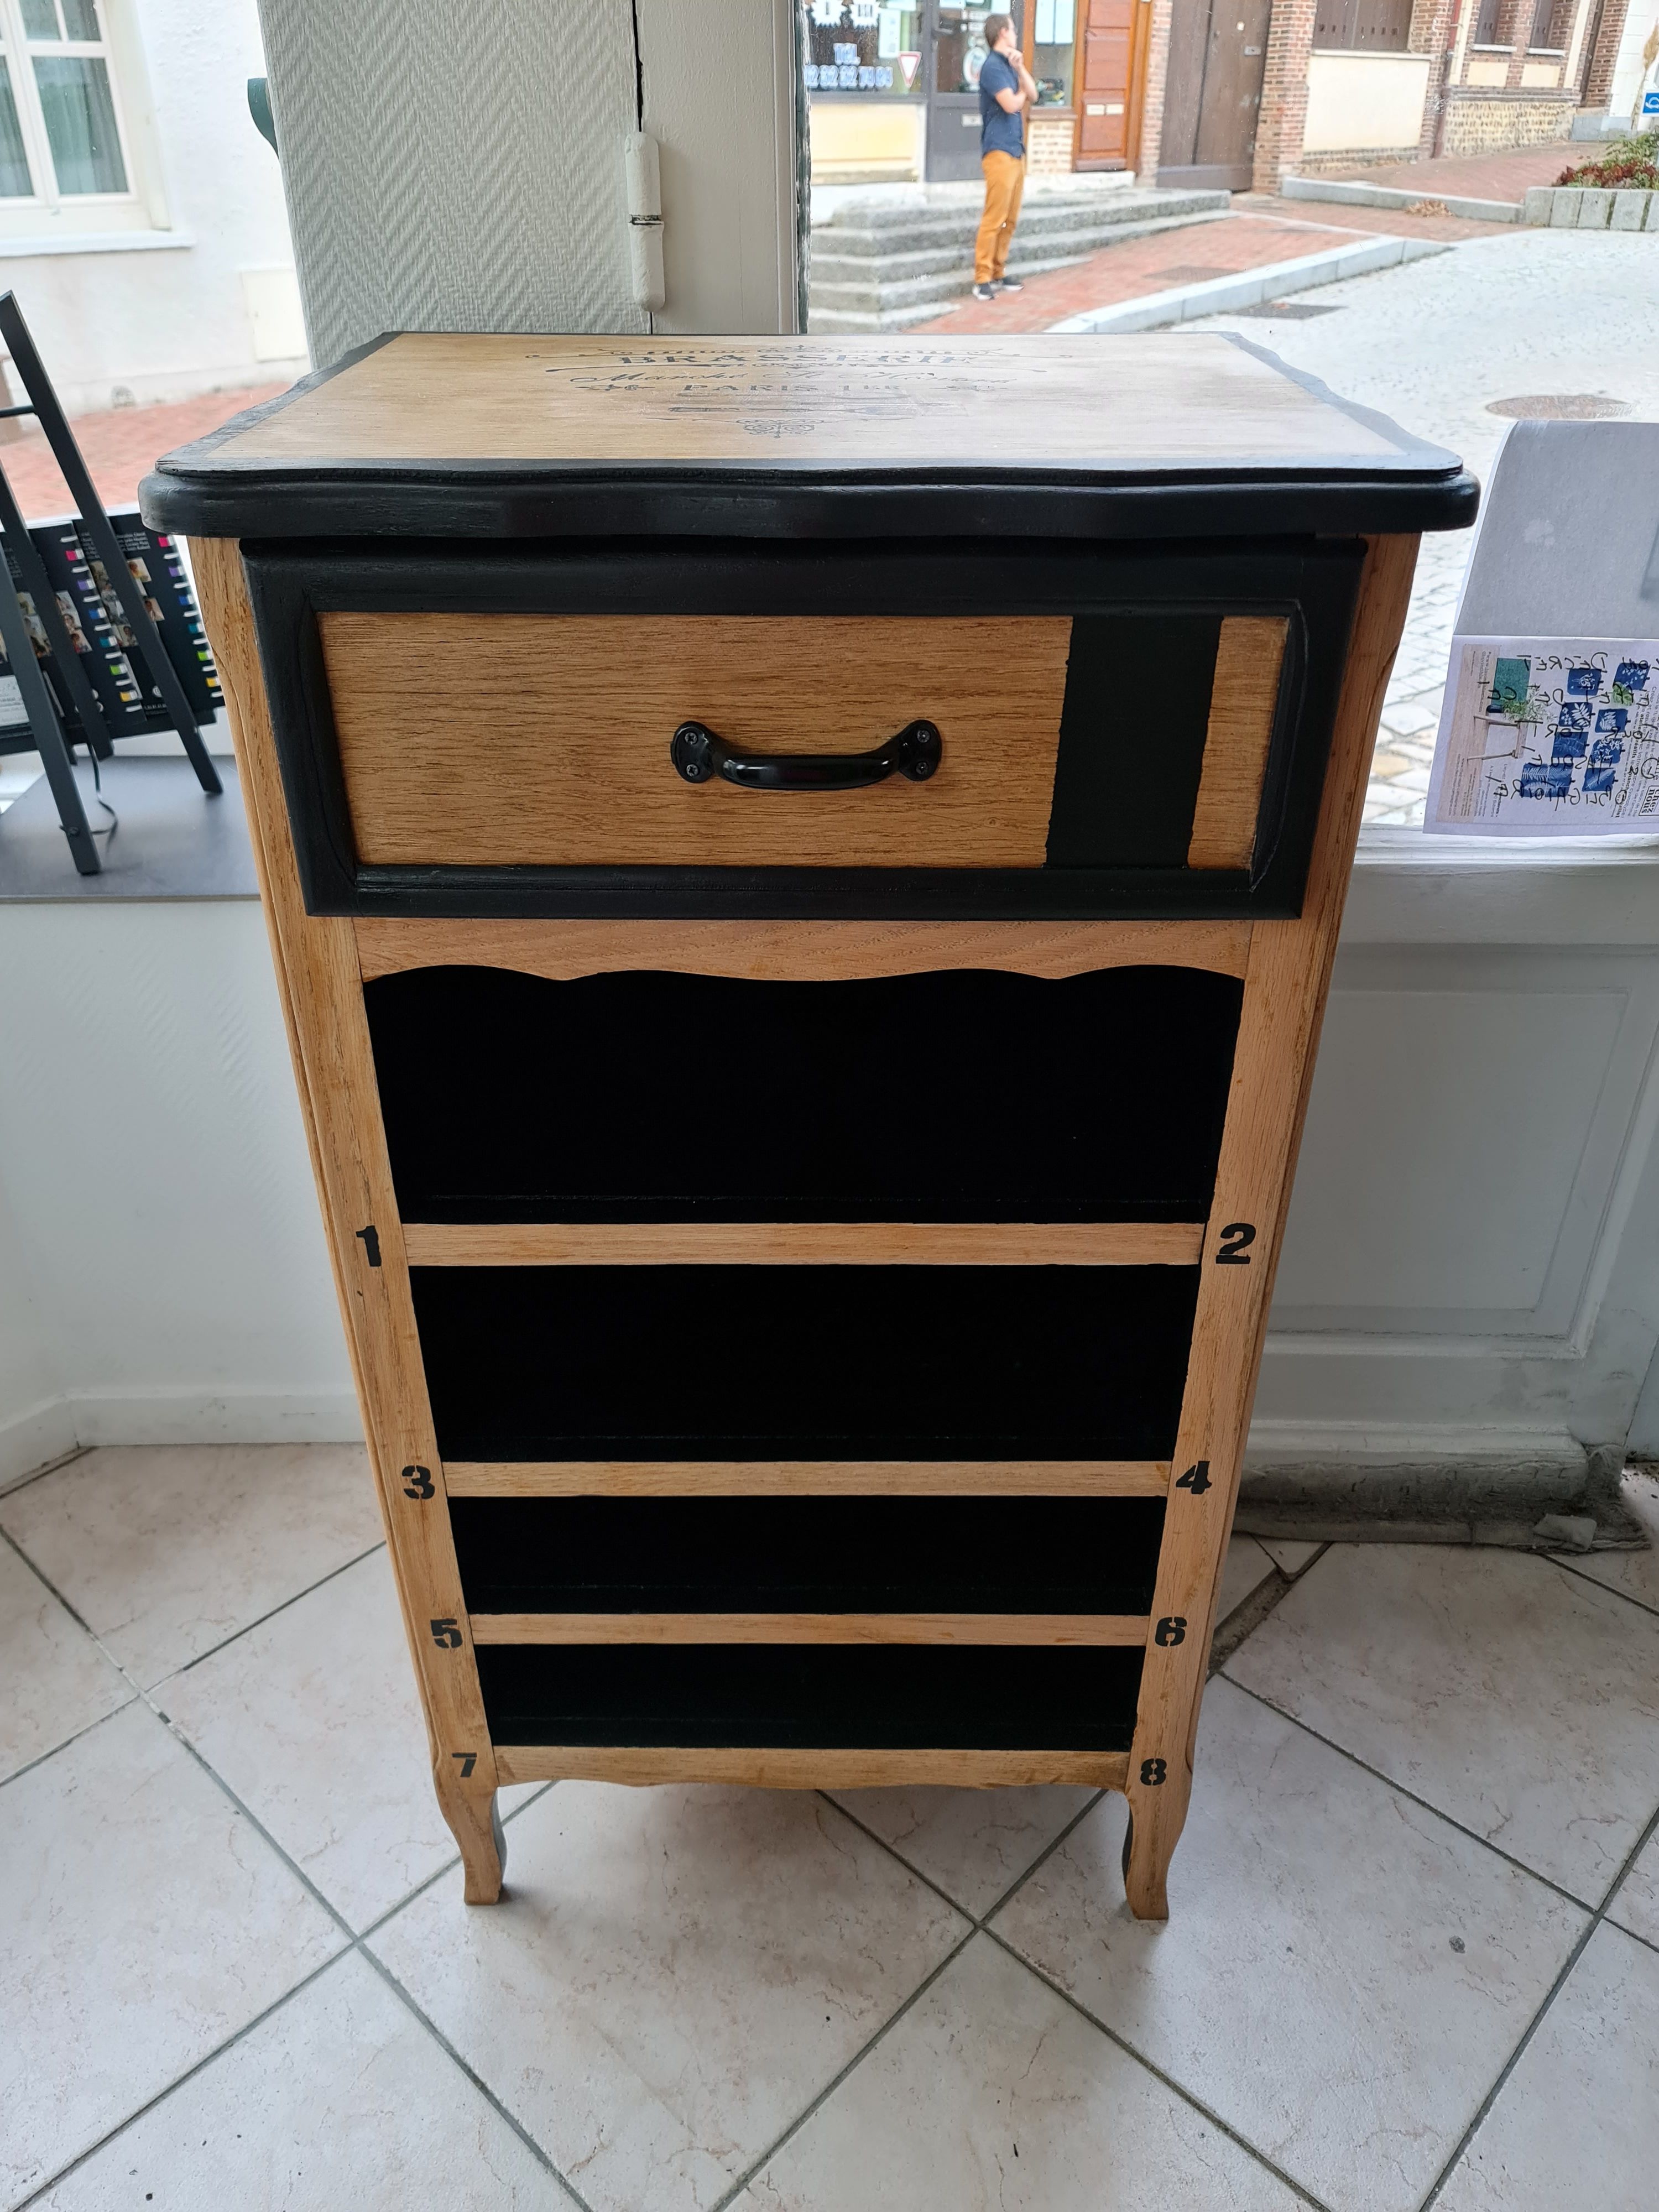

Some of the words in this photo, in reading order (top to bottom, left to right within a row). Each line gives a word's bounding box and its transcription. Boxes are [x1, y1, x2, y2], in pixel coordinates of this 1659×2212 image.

[619, 354, 977, 364] BRASSERIE
[1641, 789, 1655, 813] nous
[356, 1225, 382, 1266] 1
[1215, 1223, 1256, 1264] 2
[402, 1465, 435, 1499] 3
[1176, 1460, 1212, 1494] 4
[430, 1618, 463, 1648] 5
[1155, 1616, 1187, 1647] 6
[452, 1752, 477, 1777] 7
[1140, 1758, 1167, 1786] 8
